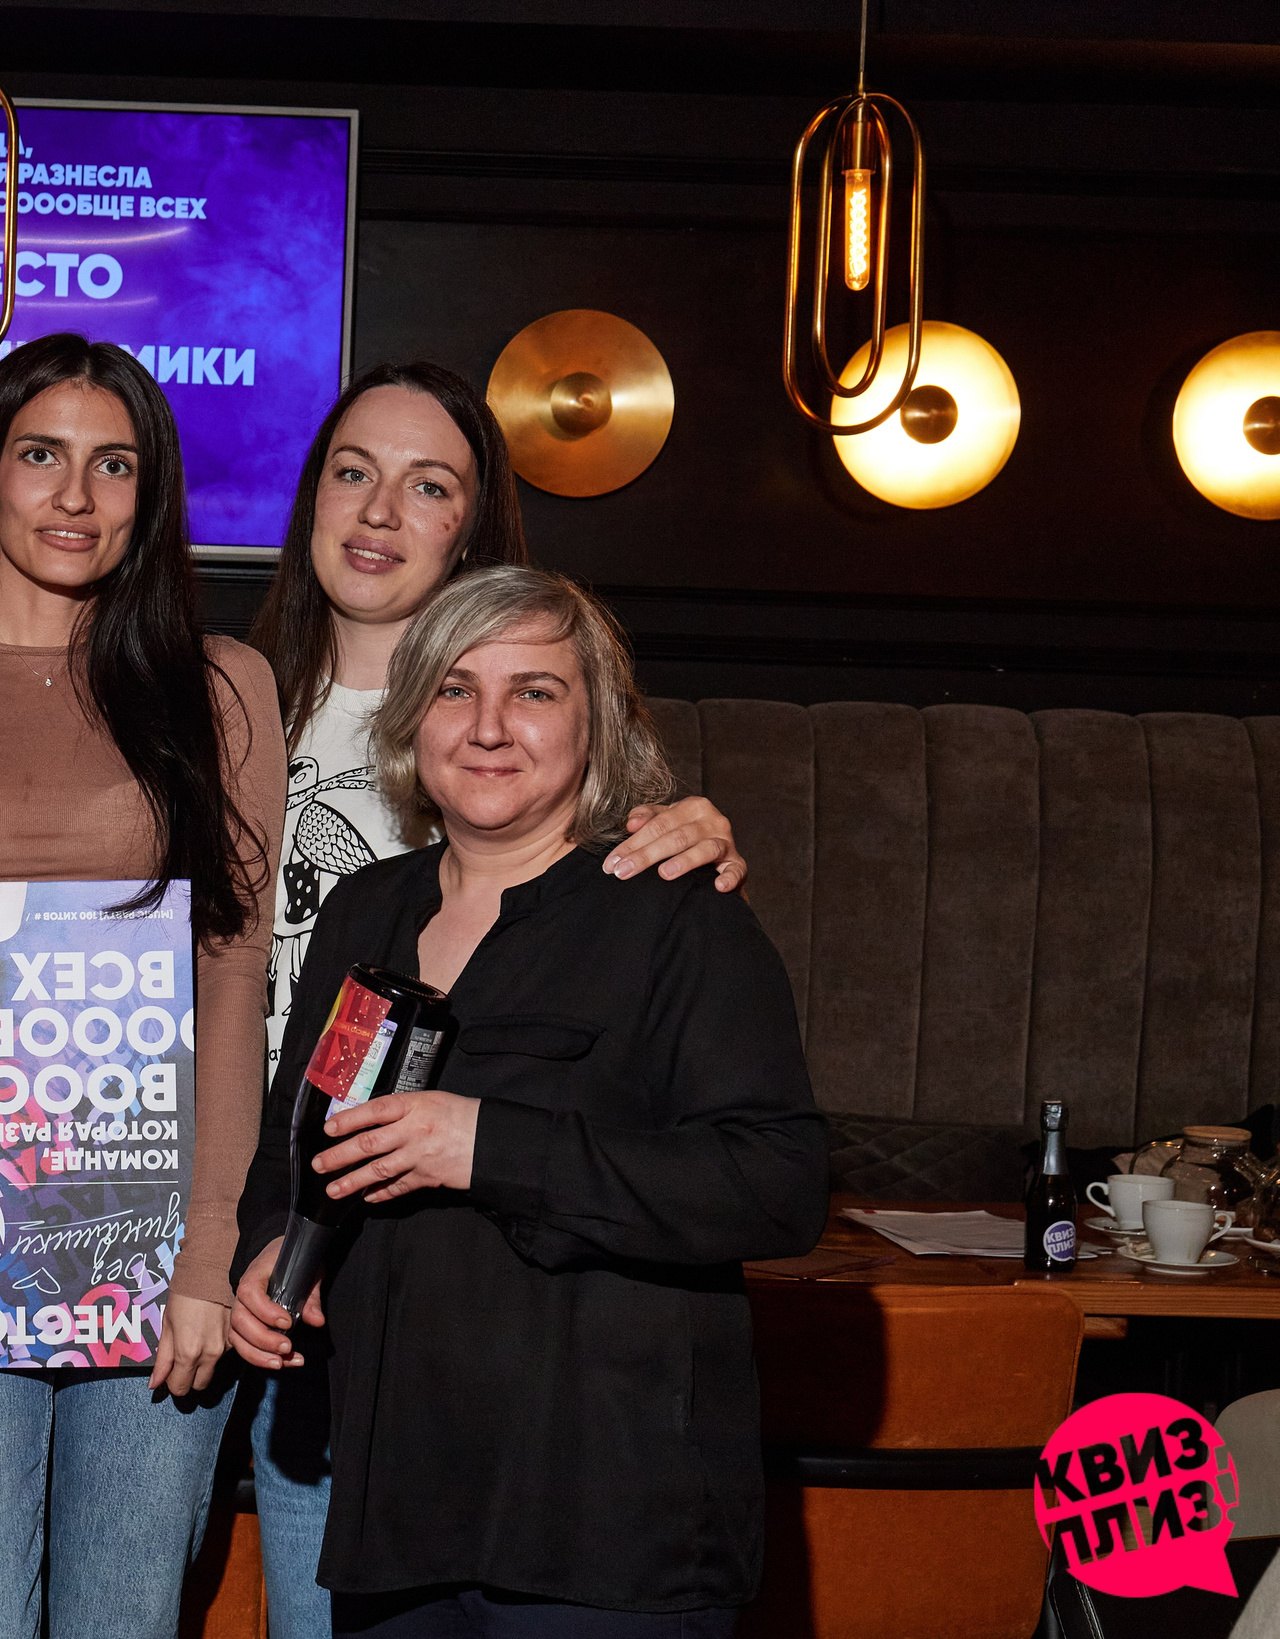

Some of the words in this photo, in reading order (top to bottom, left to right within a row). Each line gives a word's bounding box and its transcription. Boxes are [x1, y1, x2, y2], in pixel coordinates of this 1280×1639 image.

[19, 163, 153, 188] РАЗНЕСЛА
[140, 197, 207, 219] ВСЕХ
[43, 911, 77, 921] ХИТОВ
[79, 911, 97, 921] 100
[10, 950, 175, 1001] ВСЕХ
[58, 1119, 178, 1142] КОТОРАЯ
[41, 1148, 179, 1172] КОМАНДЕ,
